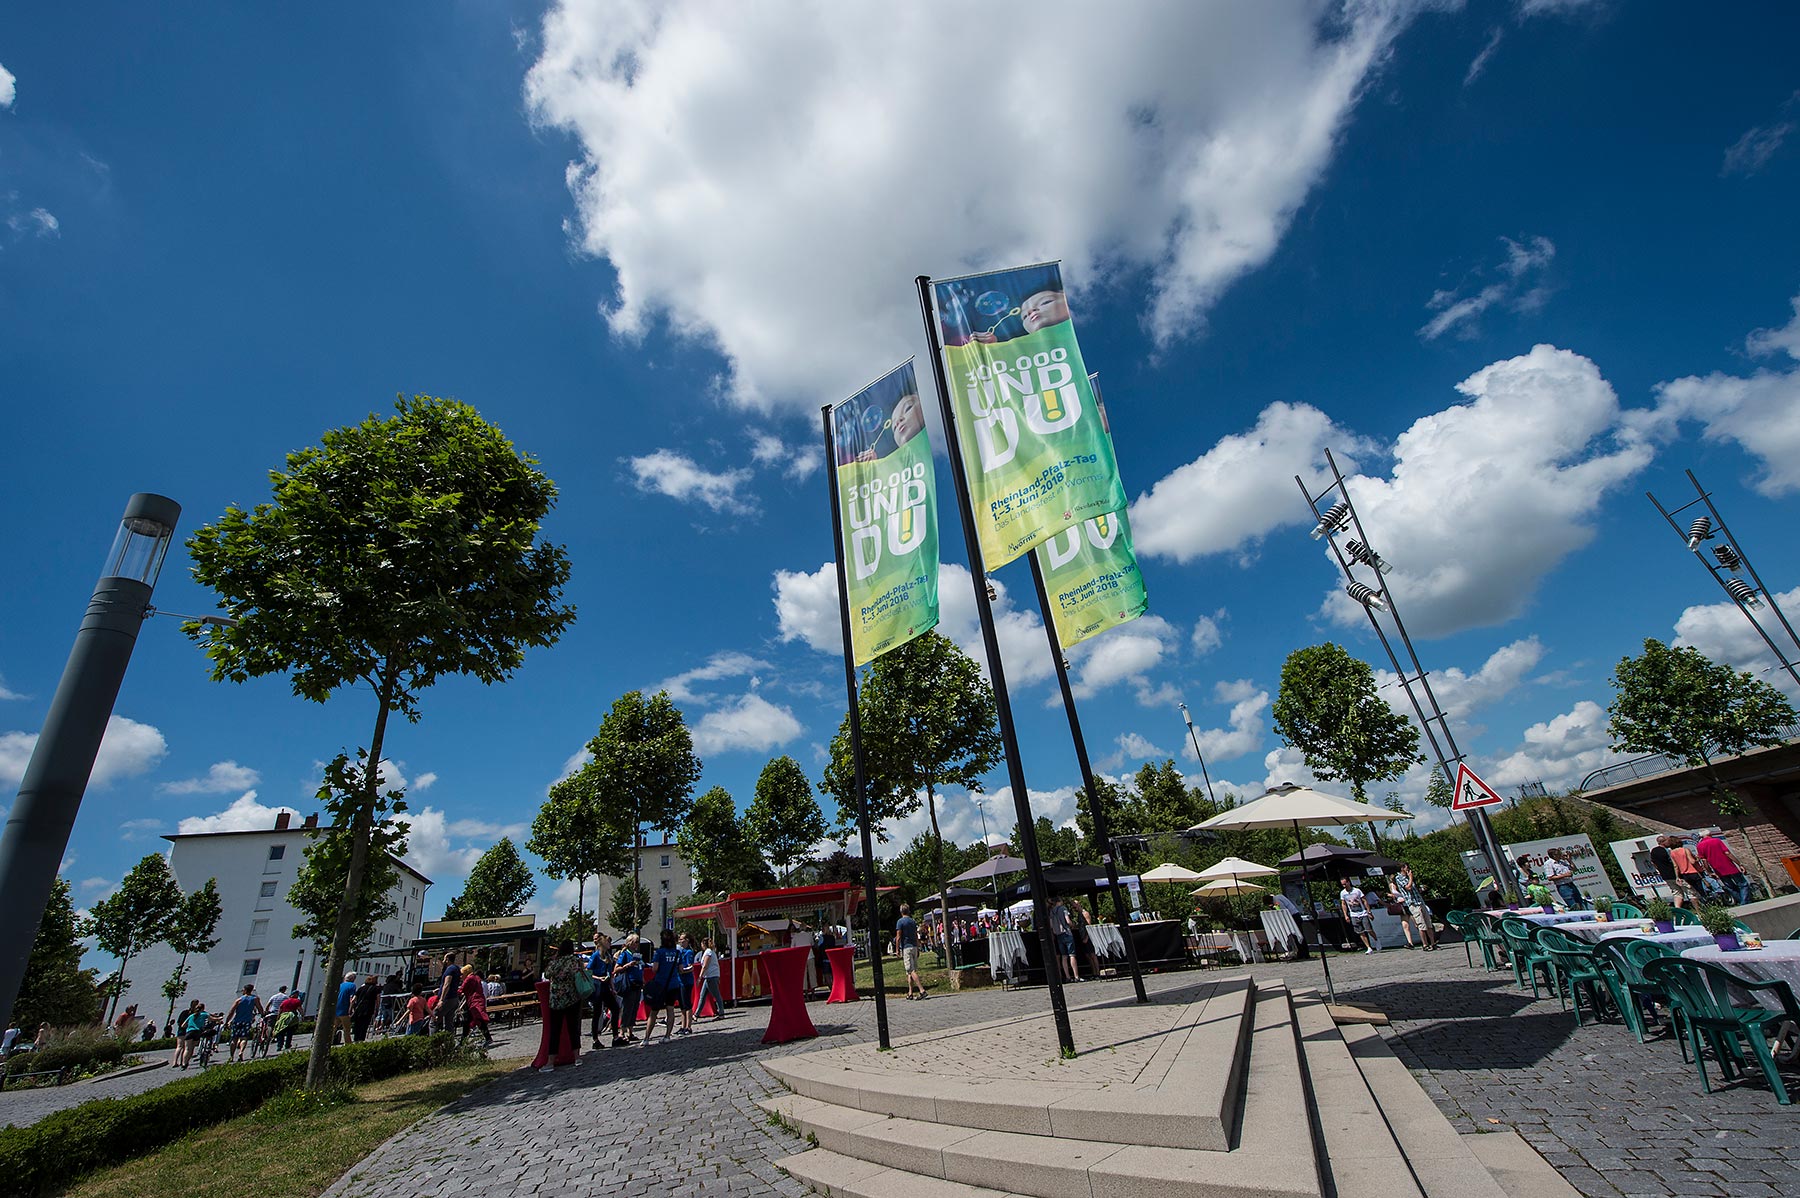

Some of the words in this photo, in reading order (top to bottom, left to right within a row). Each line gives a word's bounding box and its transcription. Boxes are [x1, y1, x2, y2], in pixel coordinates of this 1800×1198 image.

[965, 347, 1068, 389] 300.000
[967, 362, 1073, 418] UND
[848, 461, 926, 503] 300.000
[990, 452, 1098, 513] Rheinland-Pfalz-Tag
[1017, 490, 1039, 508] Juni
[1040, 471, 1065, 496] 2018
[848, 478, 927, 530] UND
[994, 519, 1010, 532] Das
[889, 592, 910, 608] 2018
[1059, 562, 1136, 602] Rheinland-Pfalz-Tag
[1080, 587, 1095, 602] Juni
[1095, 580, 1119, 594] 2018
[461, 919, 497, 928] EICHBAUM
